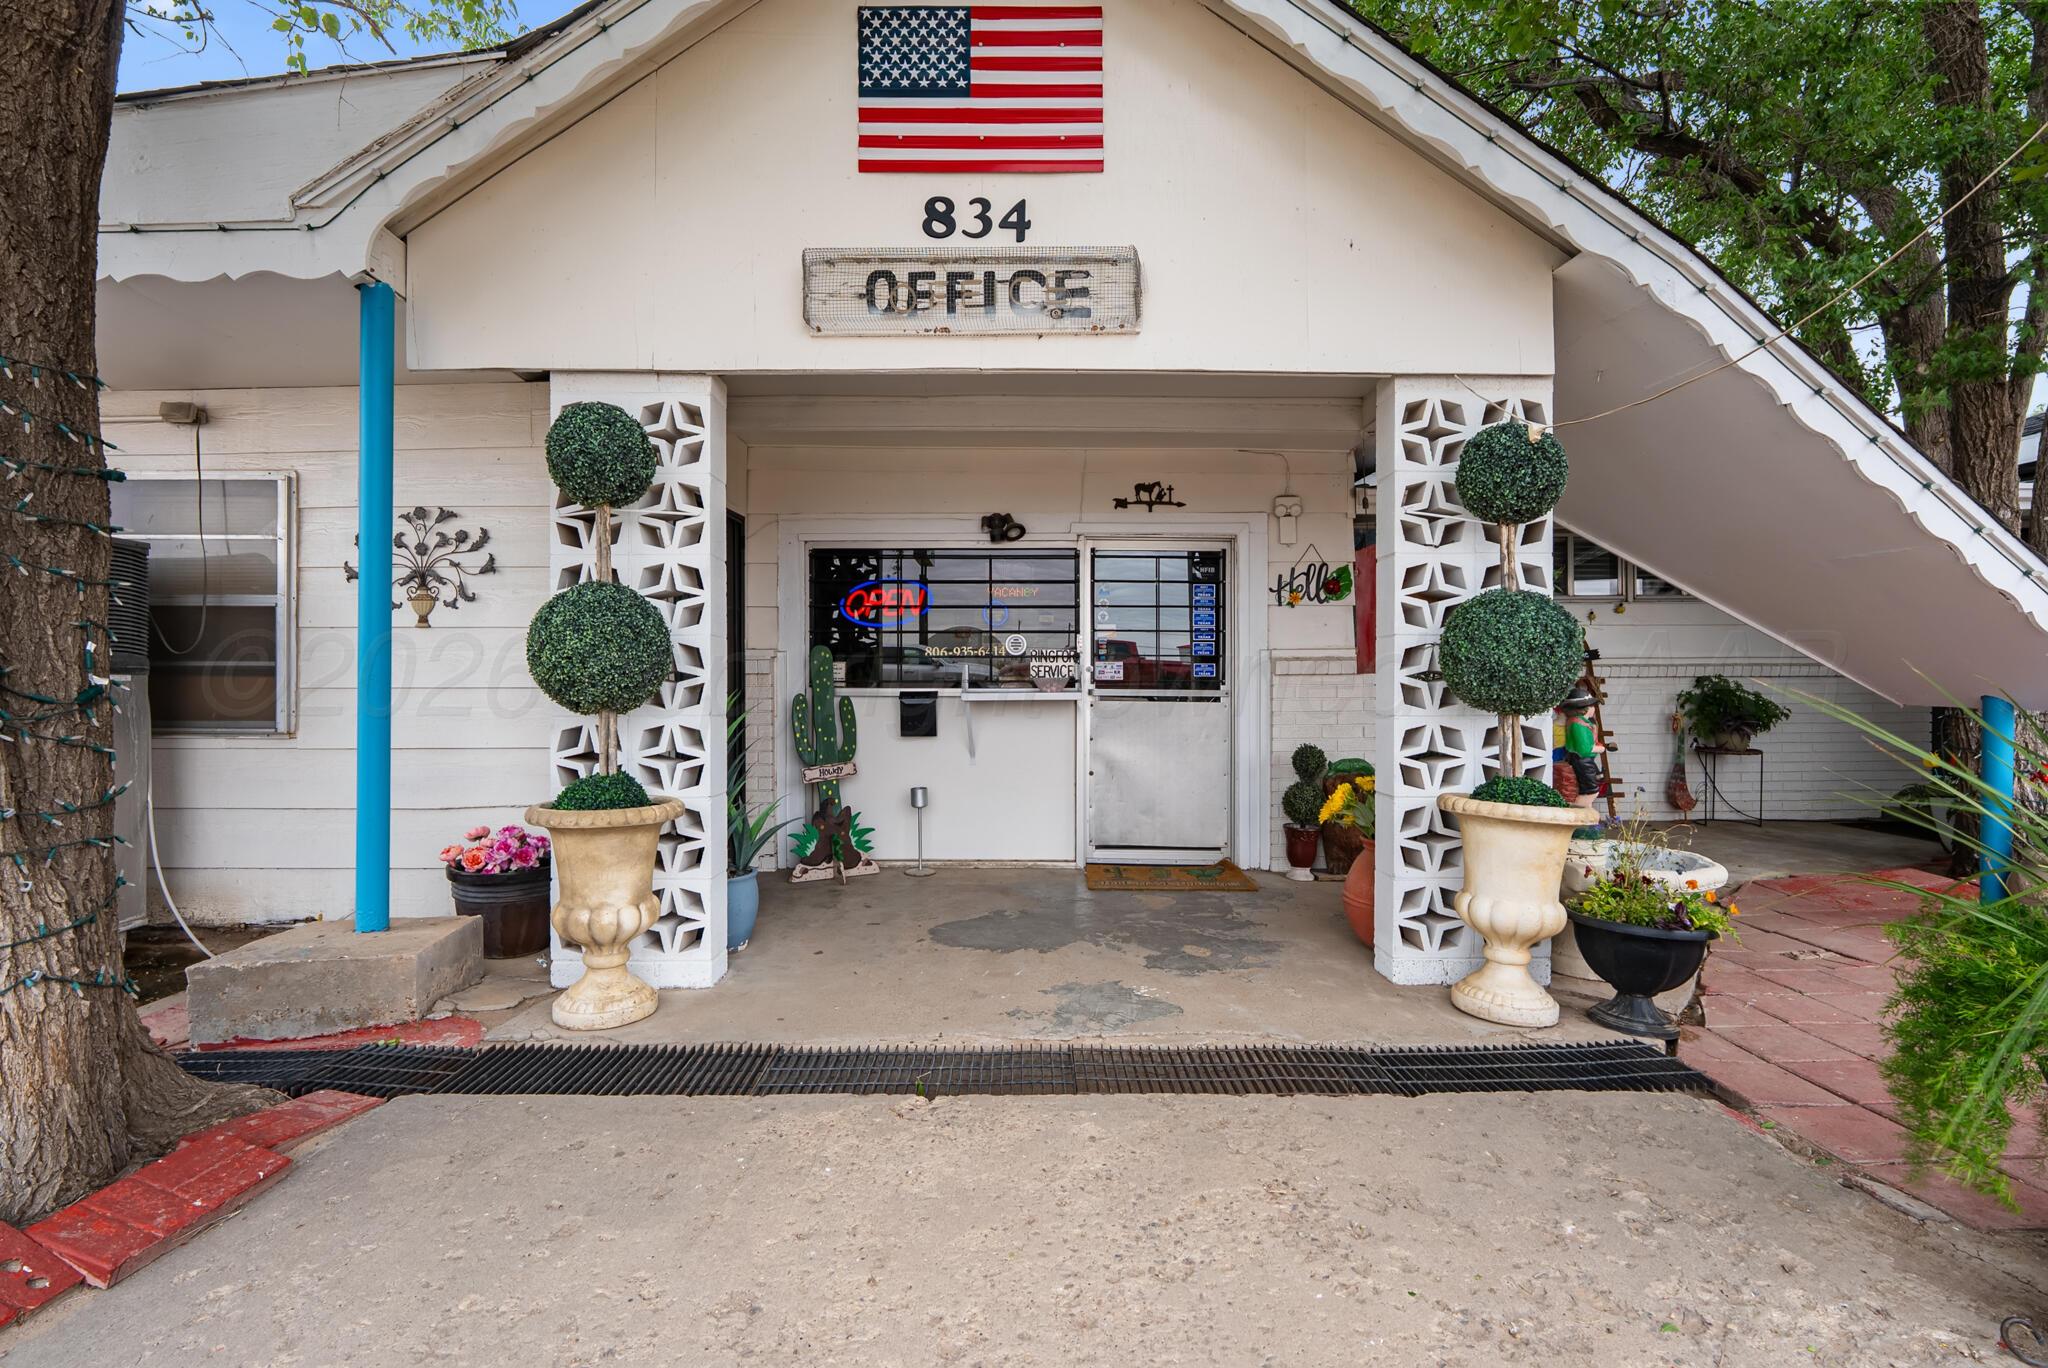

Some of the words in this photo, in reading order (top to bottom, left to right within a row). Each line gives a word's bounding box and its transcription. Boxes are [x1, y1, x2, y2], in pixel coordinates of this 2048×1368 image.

[922, 196, 1032, 243] 834
[865, 269, 1092, 319] OFFICE
[845, 588, 926, 617] OPEN
[1269, 562, 1342, 608] Hell
[1030, 664, 1074, 679] SERVICE
